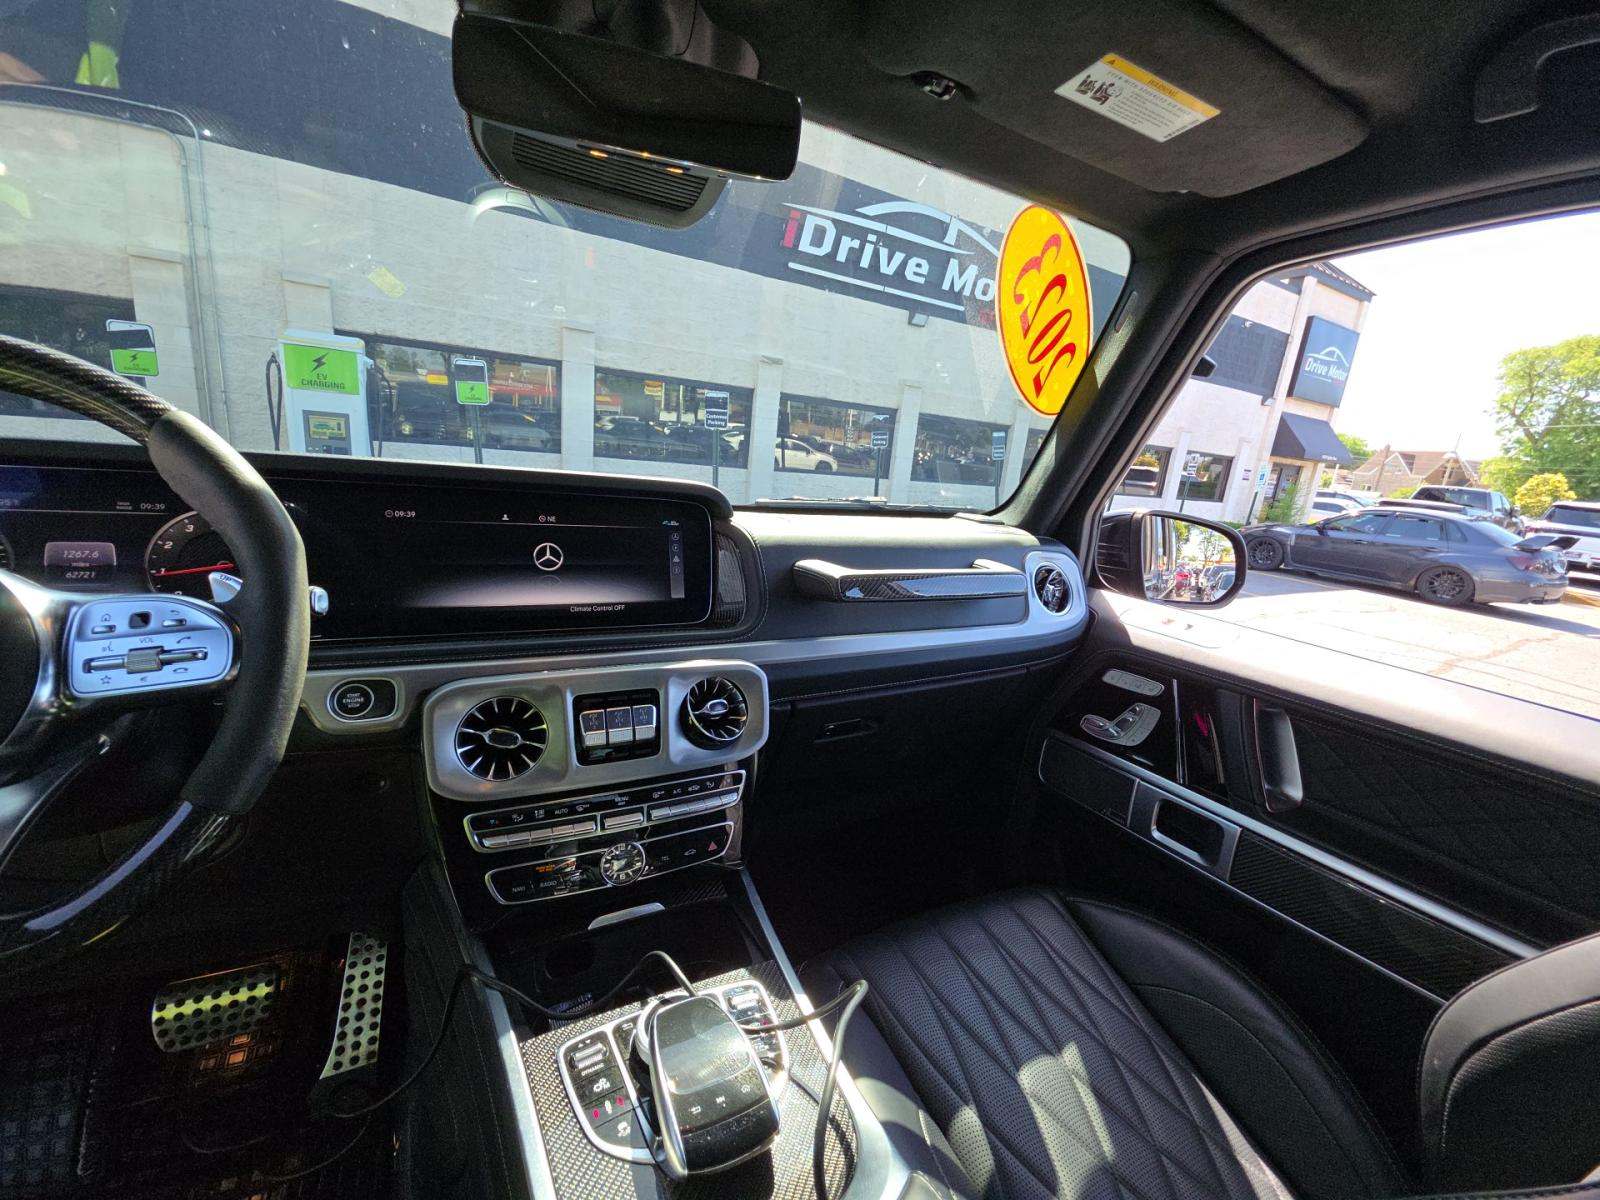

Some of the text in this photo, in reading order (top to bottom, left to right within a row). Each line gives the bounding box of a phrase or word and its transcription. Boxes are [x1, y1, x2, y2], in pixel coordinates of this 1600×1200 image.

[783, 209, 997, 301] iDrive Mo
[301, 378, 345, 390] CHARGING
[140, 502, 165, 510] 09:39
[394, 510, 416, 518] 09:39
[185, 524, 194, 532] 3
[164, 541, 173, 549] 2
[63, 550, 99, 559] 1267.6
[65, 571, 95, 579] 62721
